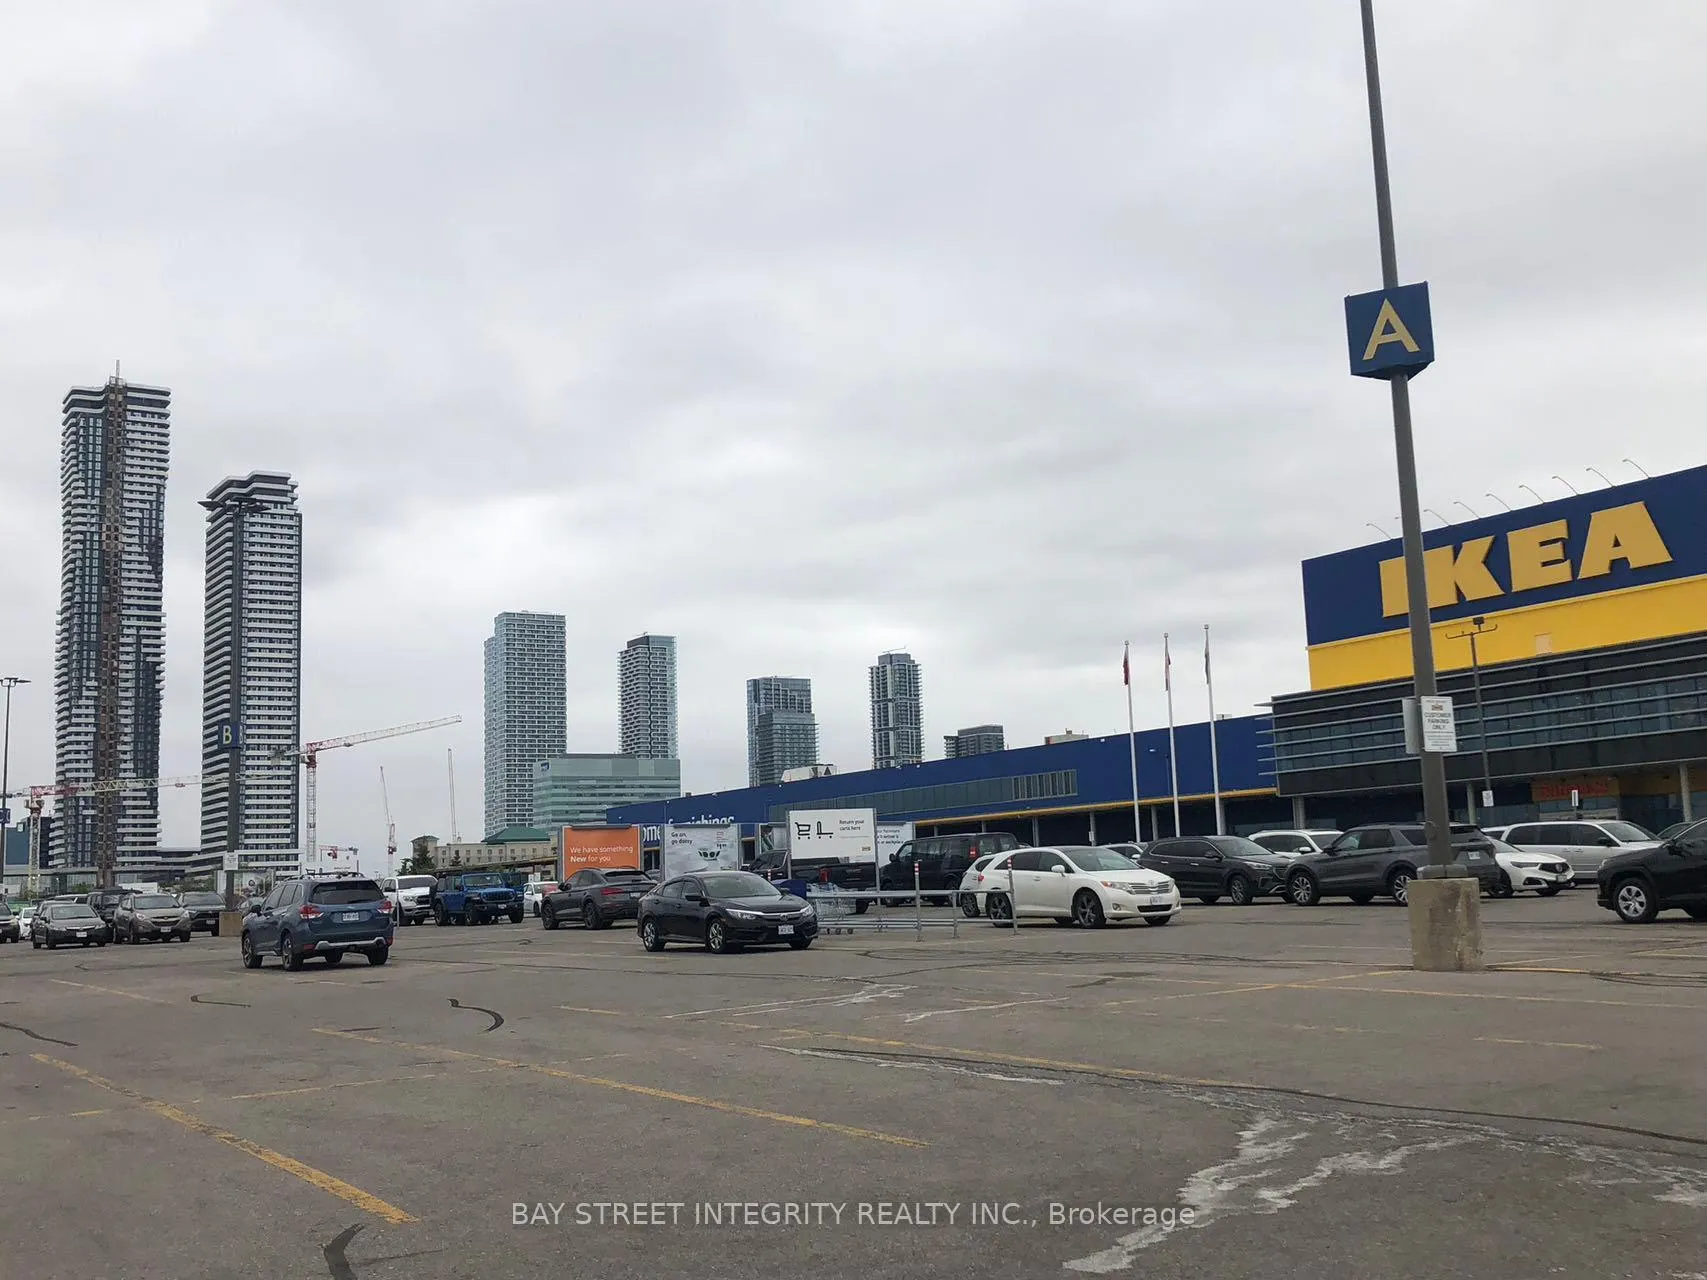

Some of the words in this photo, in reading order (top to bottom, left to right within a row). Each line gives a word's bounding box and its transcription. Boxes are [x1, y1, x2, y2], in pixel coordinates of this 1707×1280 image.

[1363, 298, 1421, 360] A
[1379, 501, 1673, 618] IKEA
[222, 725, 232, 745] B
[570, 855, 587, 863] New
[588, 854, 598, 862] for
[599, 856, 611, 864] you
[600, 845, 633, 854] something
